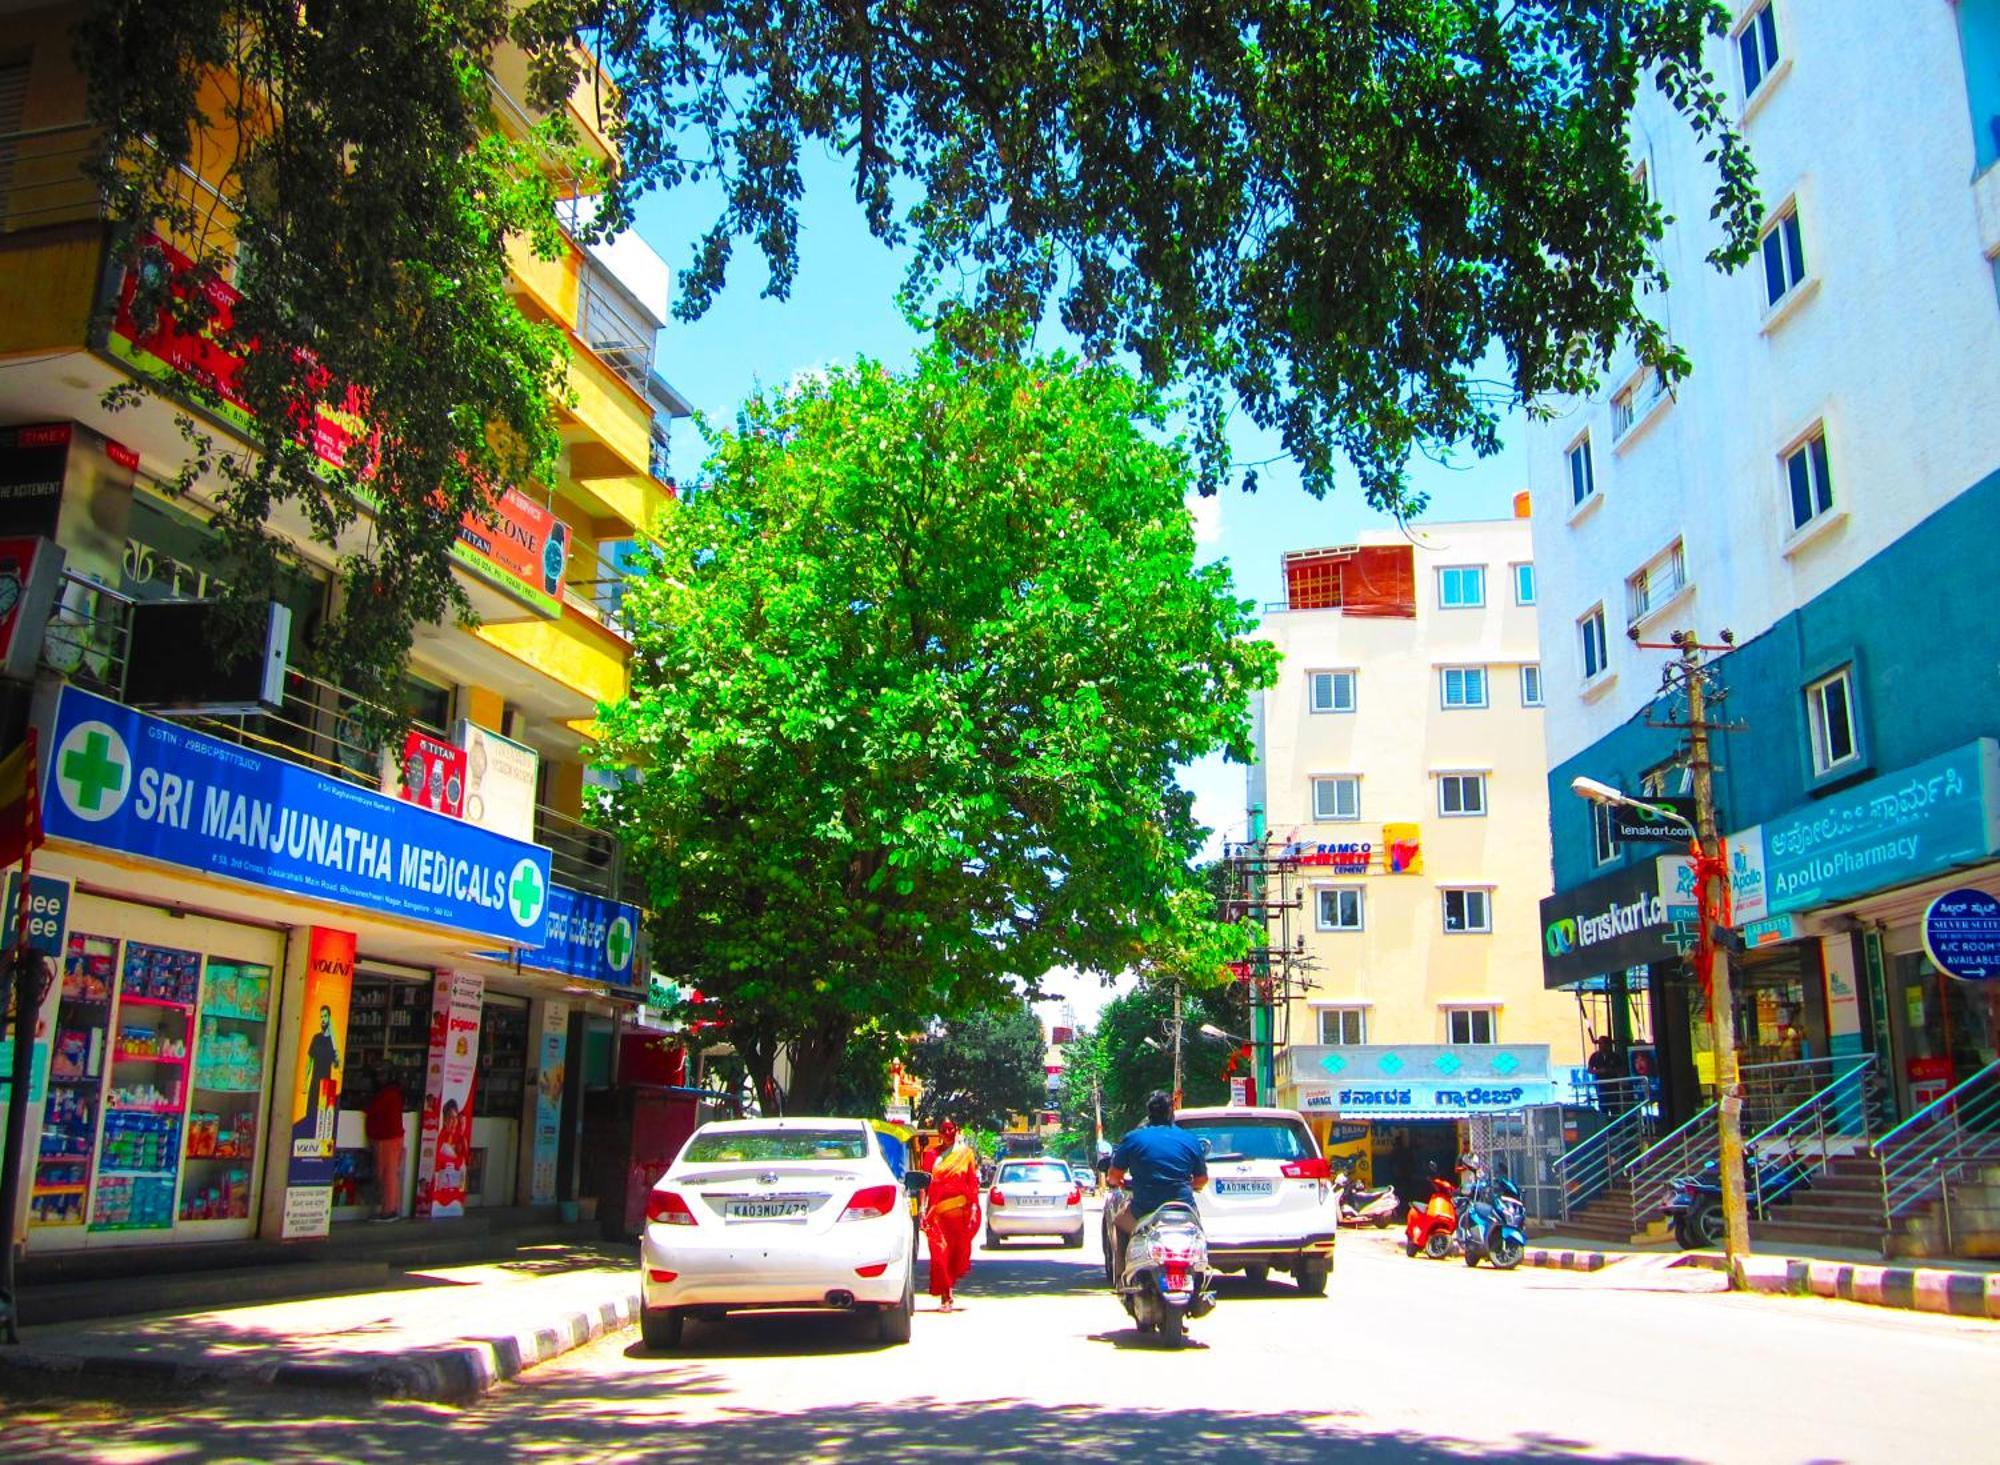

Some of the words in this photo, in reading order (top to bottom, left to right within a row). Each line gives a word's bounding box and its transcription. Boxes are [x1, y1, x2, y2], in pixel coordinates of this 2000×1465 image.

[428, 743, 456, 761] TITAN
[135, 767, 194, 830] SRI
[200, 785, 391, 883] MANJUNATHA
[401, 844, 505, 911] MEDICALS
[1316, 841, 1371, 854] RAMCO
[1732, 867, 1761, 891] Apollo
[1934, 920, 1969, 929] SILVER
[1338, 1088, 1412, 1105] ಕರ್ನಾಟಕ
